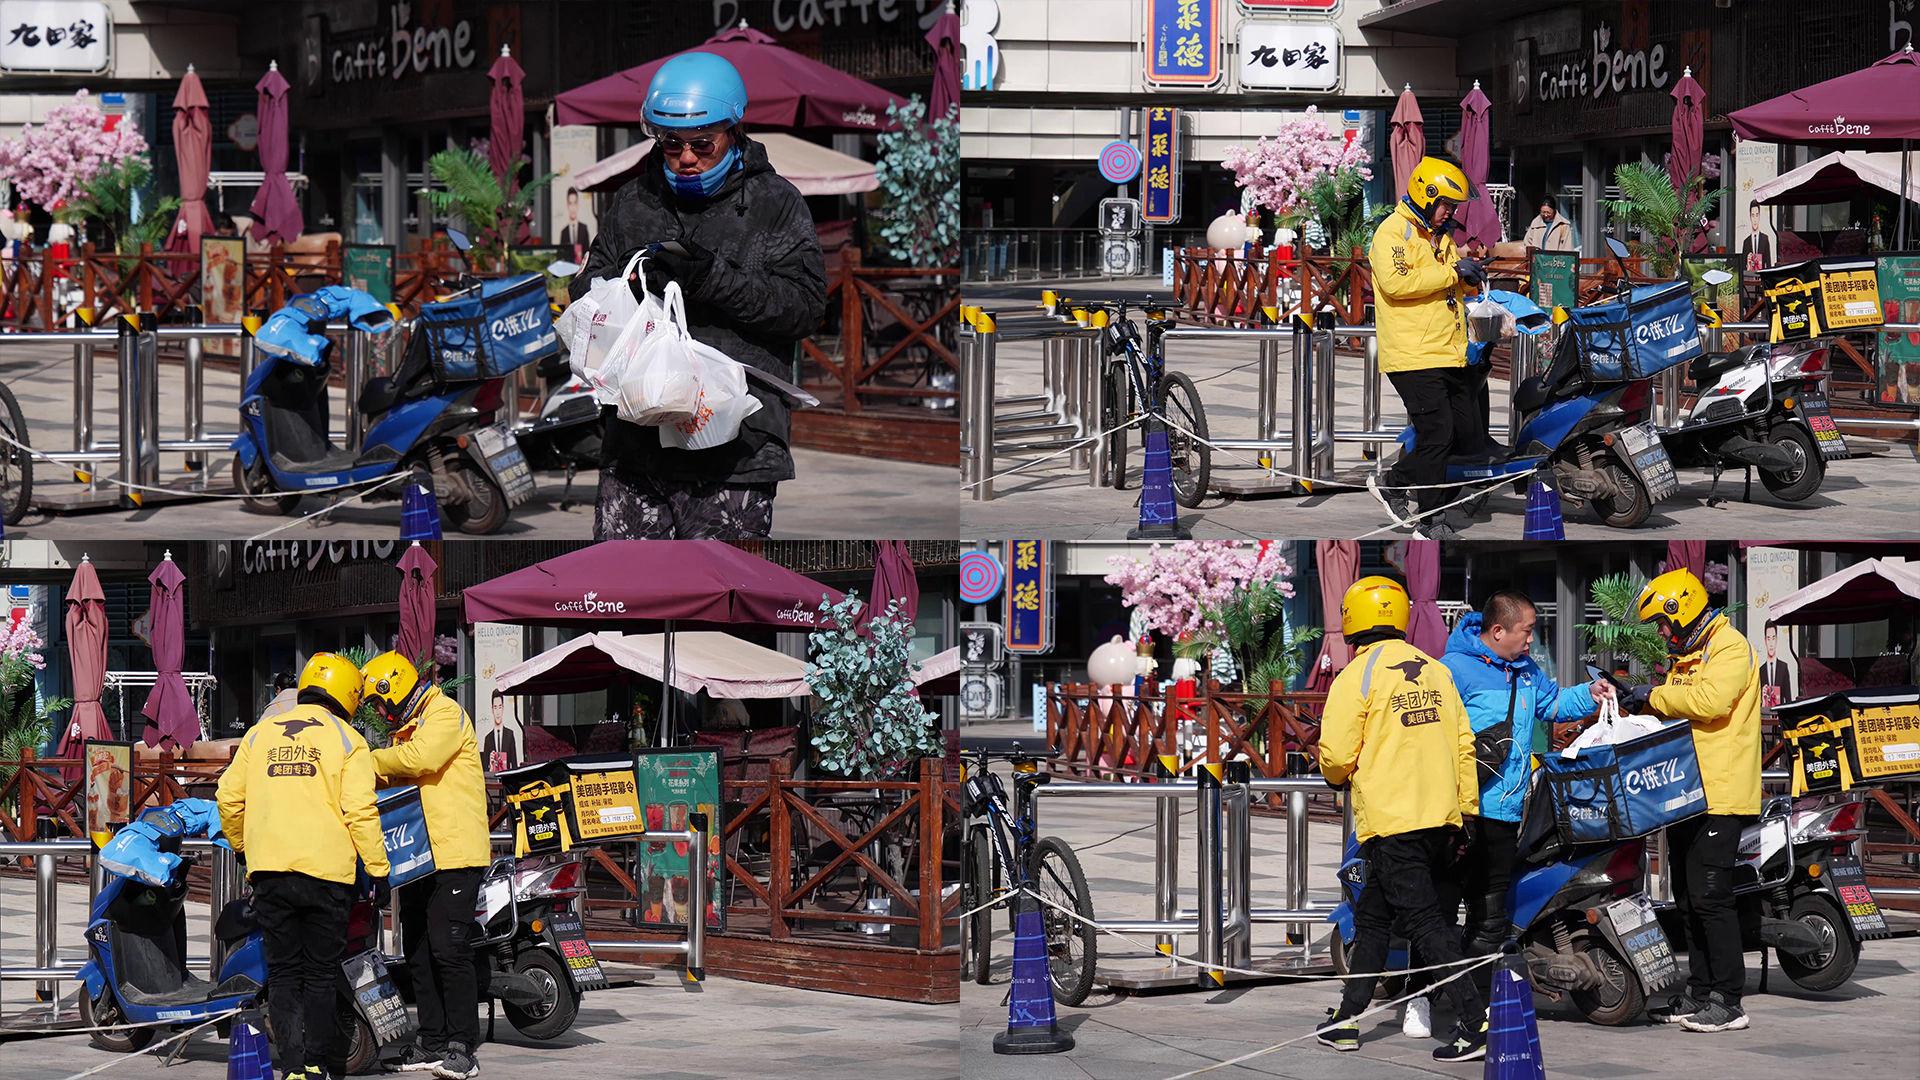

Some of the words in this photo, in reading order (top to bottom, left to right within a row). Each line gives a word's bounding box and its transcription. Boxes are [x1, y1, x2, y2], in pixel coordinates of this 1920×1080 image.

[8, 19, 97, 50] 九田家
[1247, 41, 1330, 70] 九田家
[1593, 20, 1668, 99] bene
[1833, 115, 1872, 136] bene
[1824, 279, 1876, 294] 美团骑手招募令
[584, 591, 627, 614] bene
[792, 600, 815, 624] bene
[1391, 689, 1443, 714] 美团外卖
[1857, 715, 1920, 734] 美团骑手招募令
[267, 745, 322, 764] 美团外卖
[272, 764, 313, 776] 美团专送
[1806, 759, 1838, 773] 美团外卖
[575, 780, 635, 798] 美团骑手招募令
[528, 821, 558, 835] 美团外卖
[1633, 941, 1671, 967] 美团专供
[367, 994, 402, 1019] 美团专供
